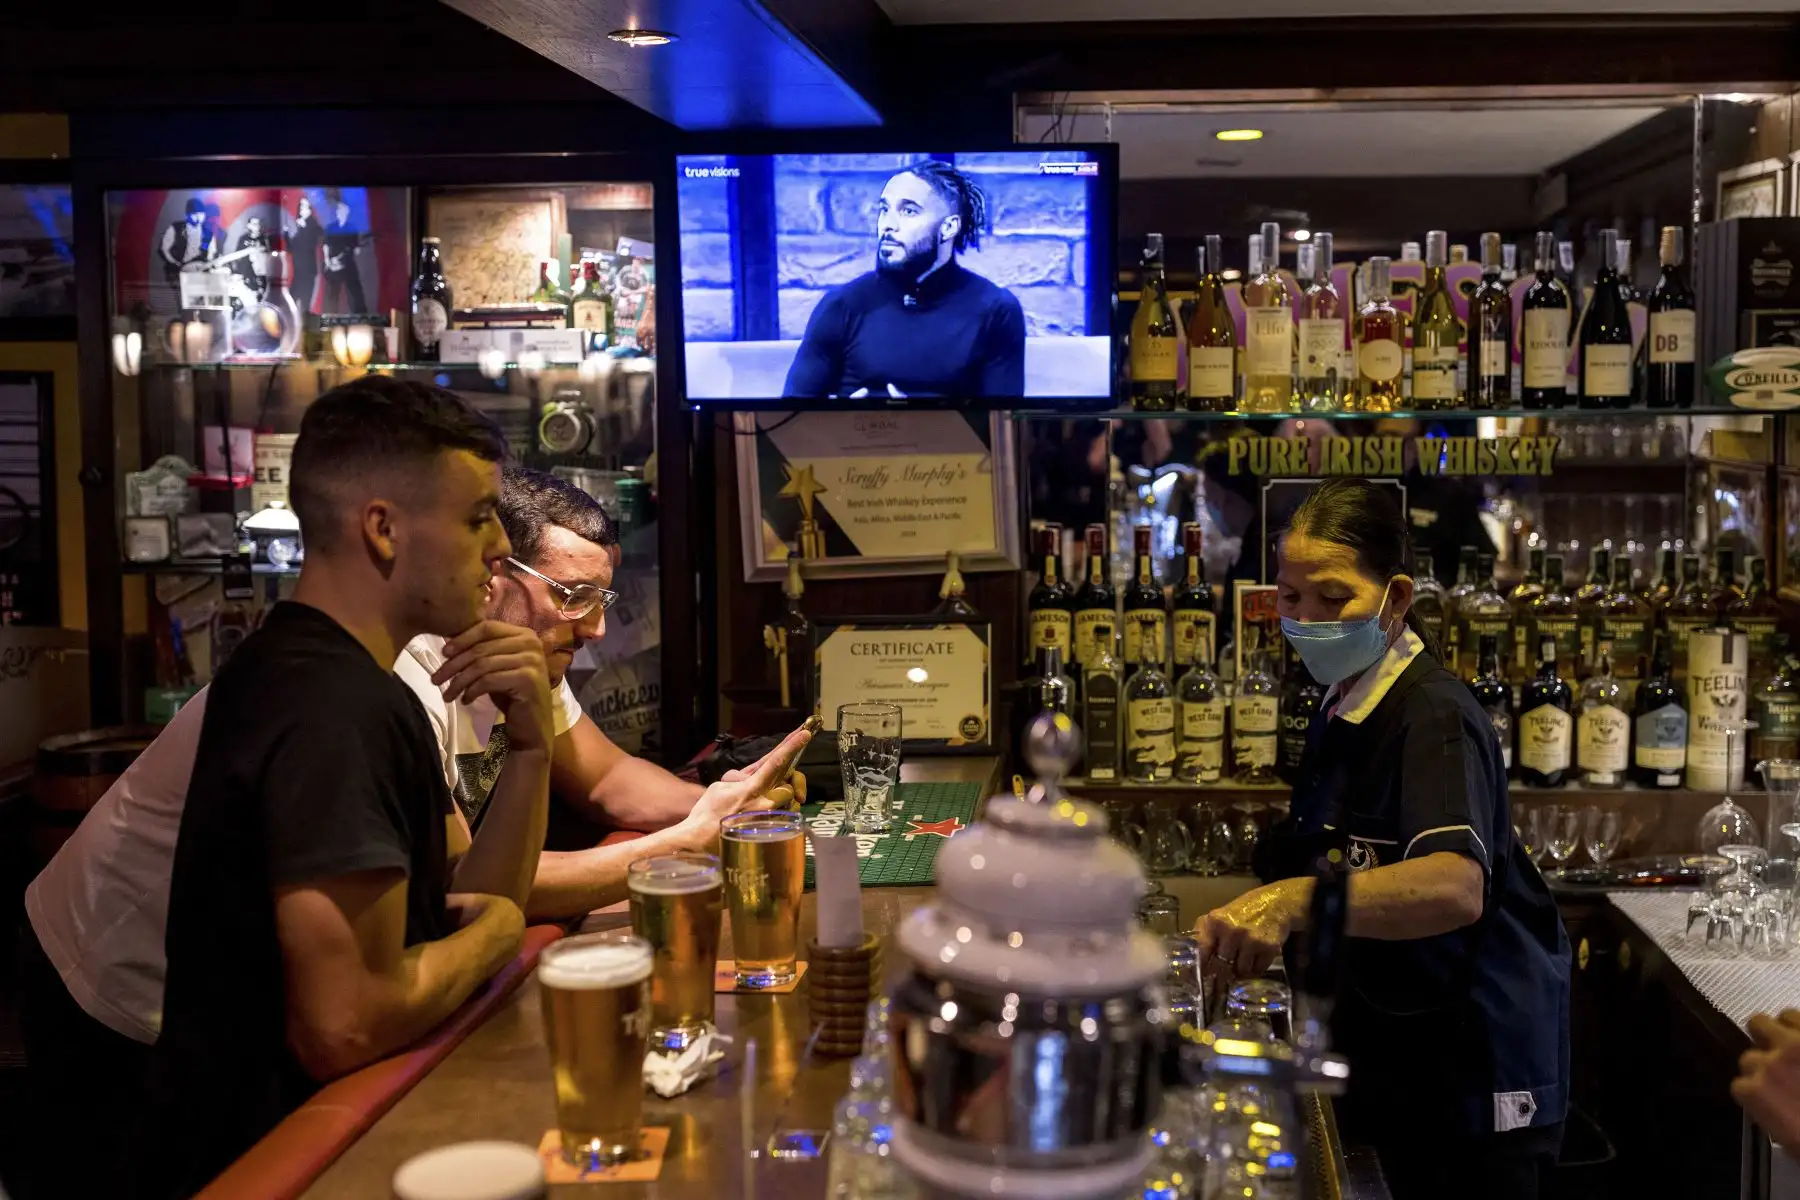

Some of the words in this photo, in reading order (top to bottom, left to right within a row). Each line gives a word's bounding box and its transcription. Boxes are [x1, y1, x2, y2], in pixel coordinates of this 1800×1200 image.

[685, 166, 709, 177] true
[710, 166, 740, 177] visions
[1655, 333, 1679, 352] DB
[1228, 436, 1311, 476] PURE
[1317, 436, 1404, 476] IRISH
[1415, 436, 1562, 476] WHISKEY
[838, 464, 890, 489] Scruffy
[895, 461, 968, 488] Murphy's
[847, 498, 865, 508] Best
[866, 498, 884, 508] Irish
[921, 495, 968, 508] Experience
[1032, 612, 1070, 623] JAMESON
[850, 642, 955, 656] CERTIFICATE
